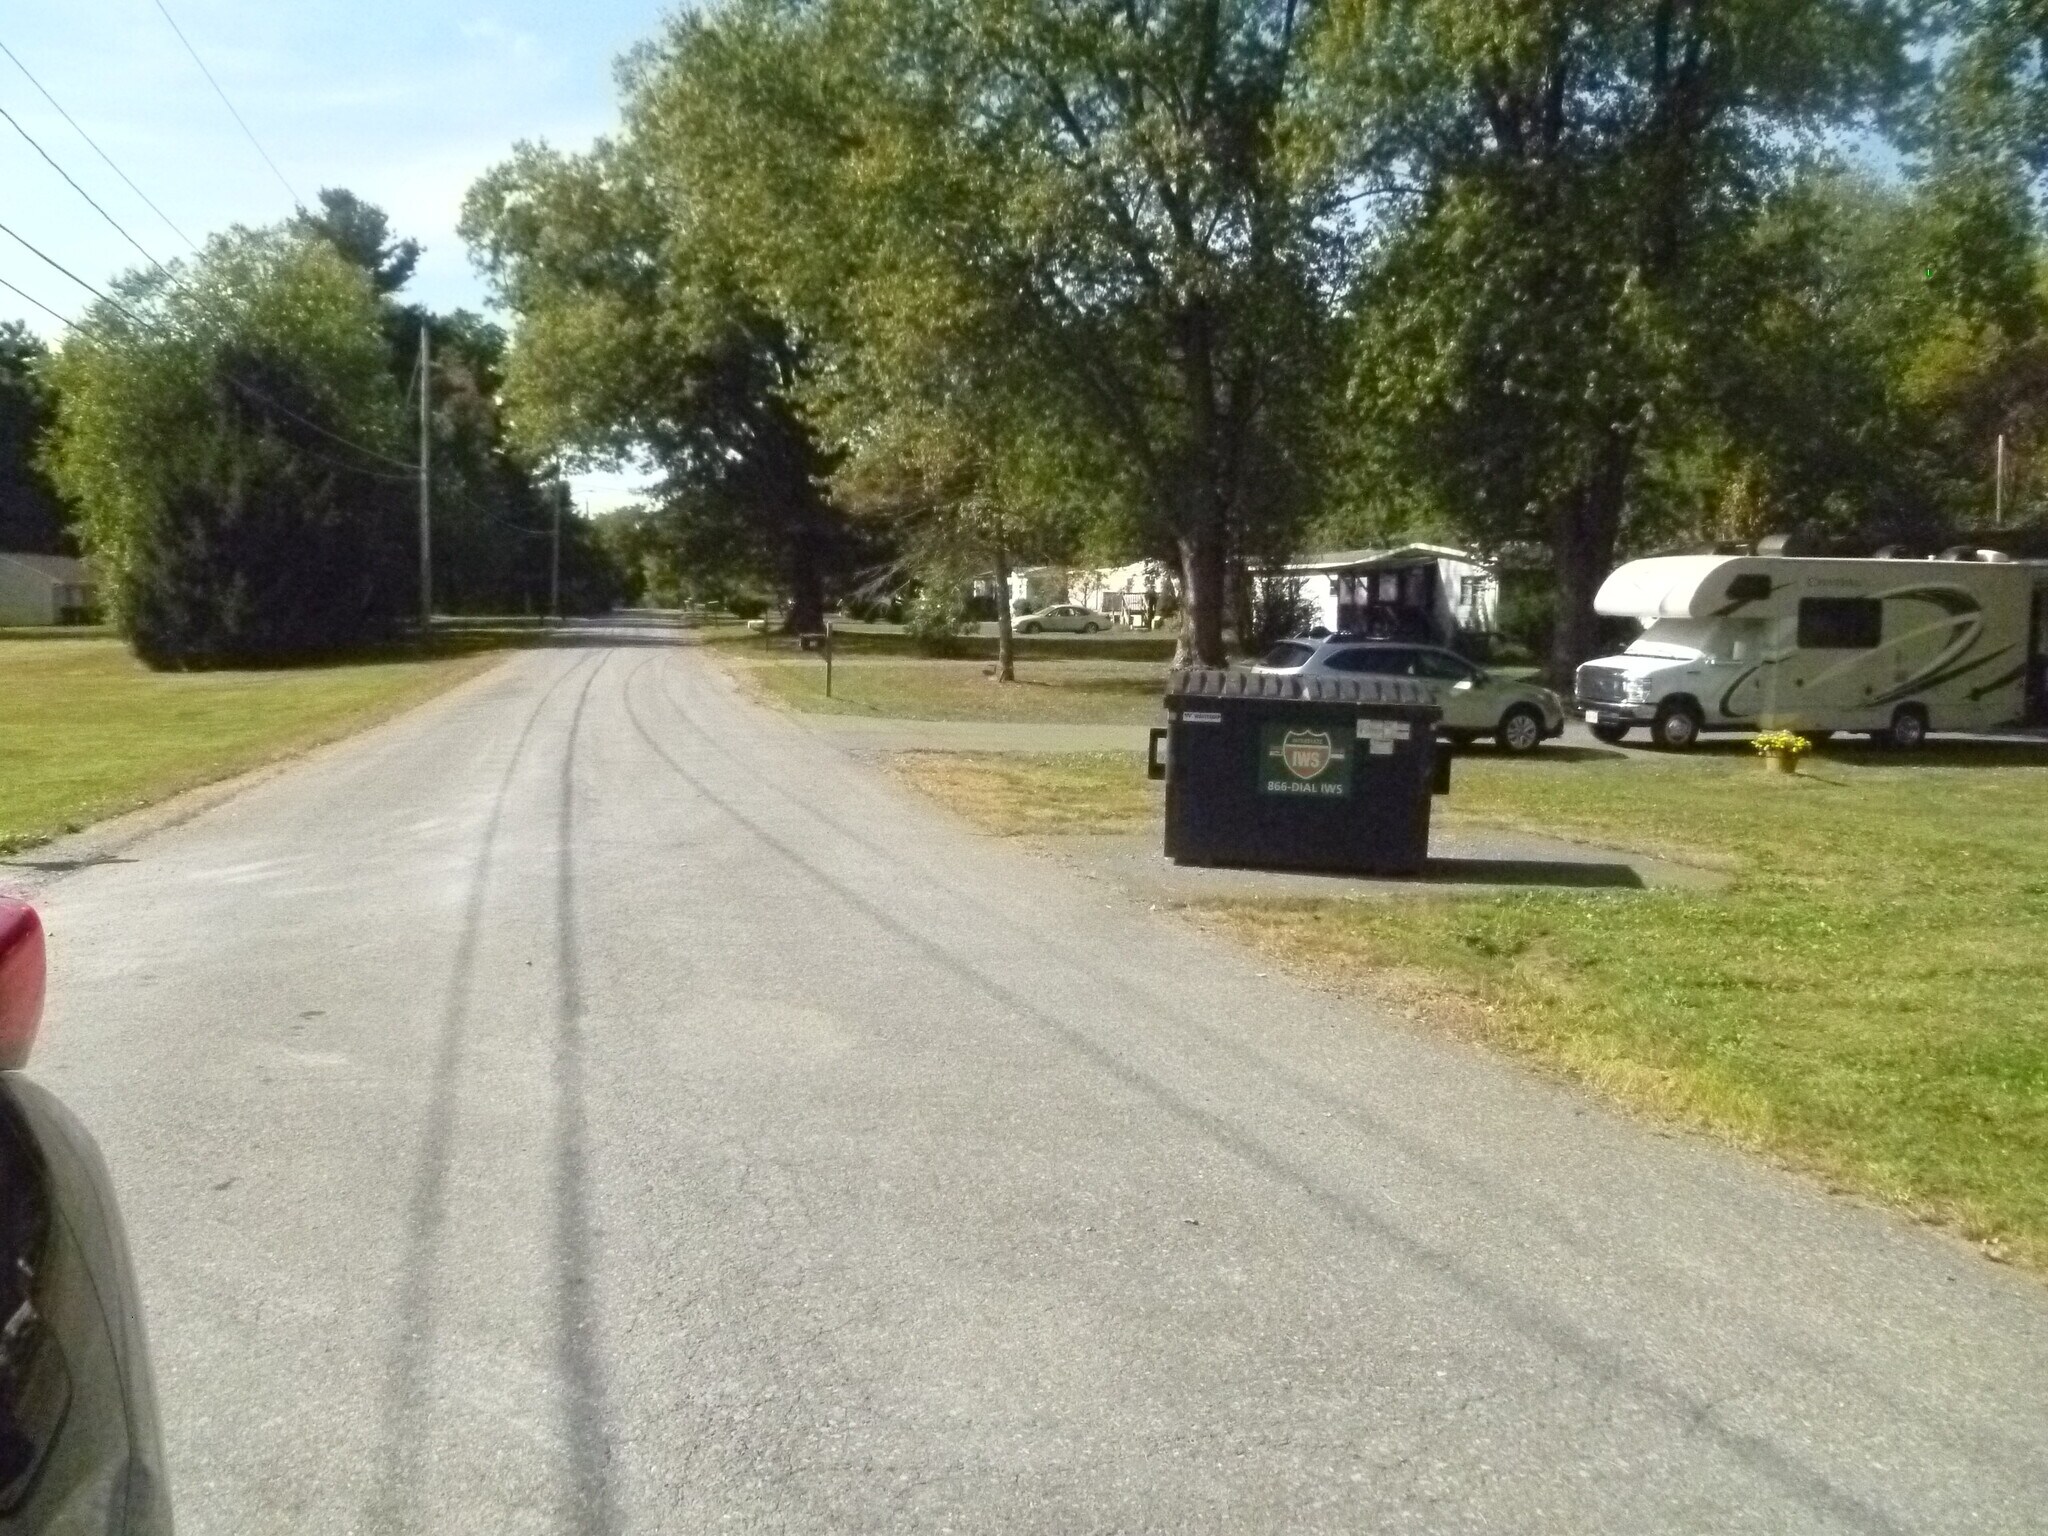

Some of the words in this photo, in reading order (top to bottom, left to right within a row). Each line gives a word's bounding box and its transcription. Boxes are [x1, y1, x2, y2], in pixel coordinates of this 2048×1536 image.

[1292, 750, 1320, 768] IWS
[1267, 781, 1318, 793] 866-DIAL
[1320, 783, 1343, 794] IWS
